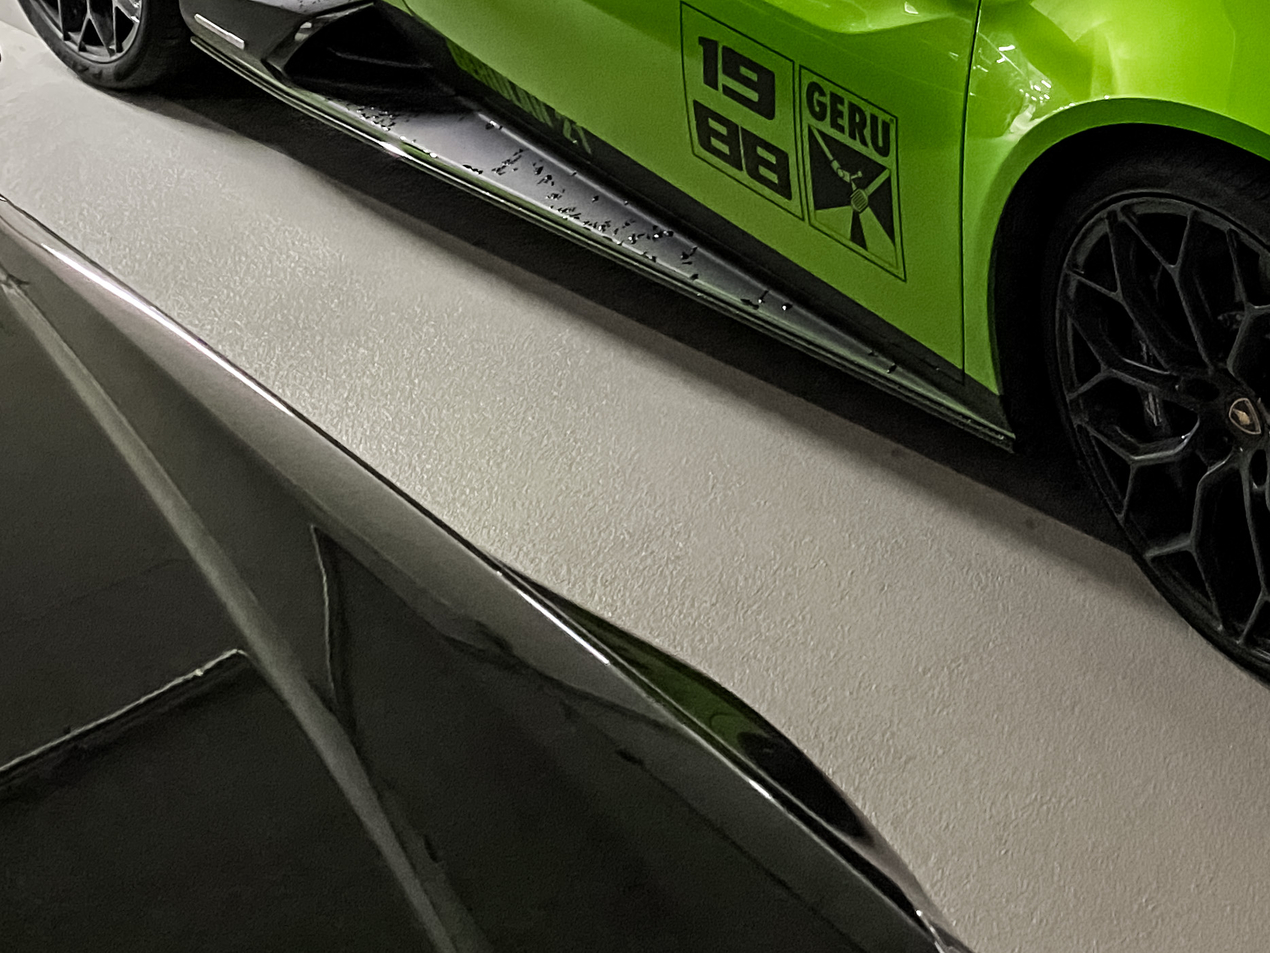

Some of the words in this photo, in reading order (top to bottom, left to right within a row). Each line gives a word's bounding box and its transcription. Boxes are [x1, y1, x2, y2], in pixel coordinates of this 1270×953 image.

[697, 36, 776, 121] 19
[805, 81, 892, 157] GERU
[693, 99, 793, 201] 88
